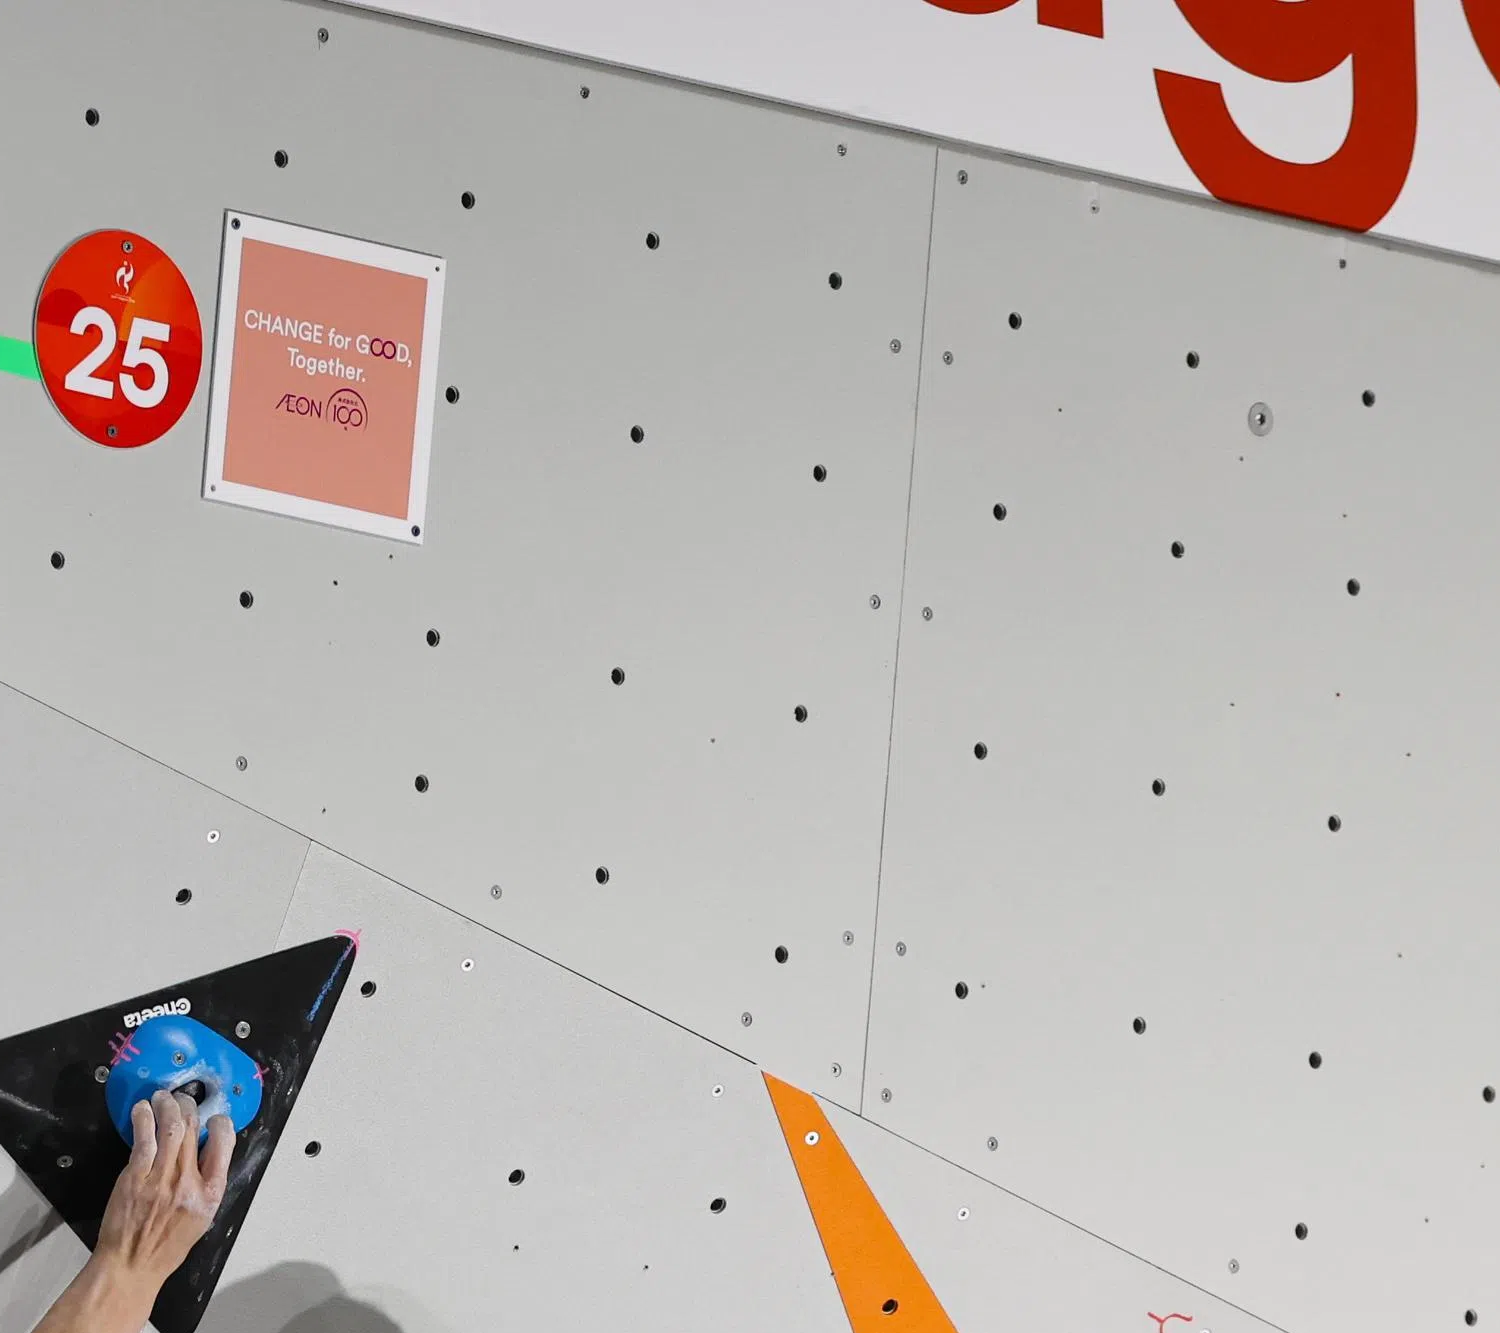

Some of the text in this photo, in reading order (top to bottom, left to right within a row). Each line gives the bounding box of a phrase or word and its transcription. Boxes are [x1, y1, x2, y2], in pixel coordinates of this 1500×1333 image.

[64, 305, 171, 410] 25
[244, 309, 413, 368] CHANGE for GOOD,
[287, 346, 366, 383] Together.
